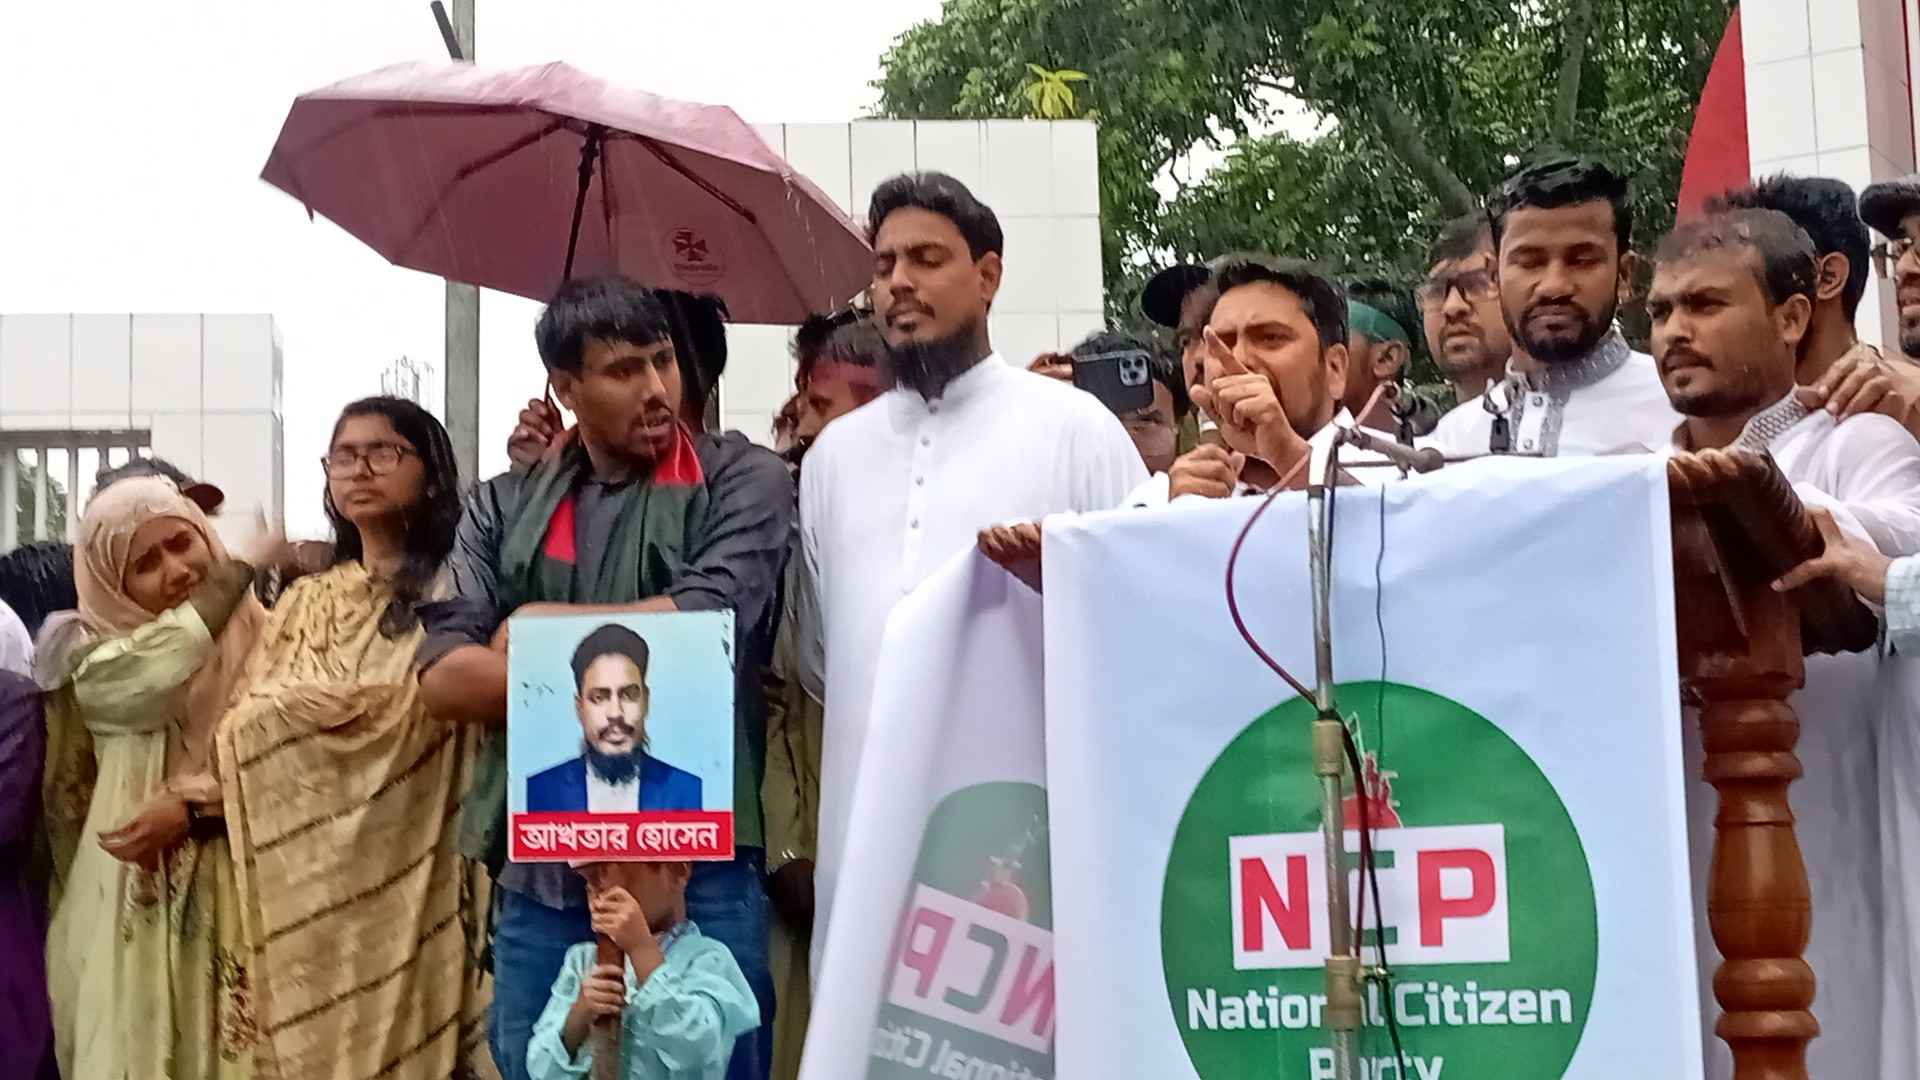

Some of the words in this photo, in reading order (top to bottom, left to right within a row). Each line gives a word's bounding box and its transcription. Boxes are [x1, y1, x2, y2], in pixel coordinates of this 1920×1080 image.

[519, 820, 629, 851] আখতার
[636, 820, 719, 851] হোসেন
[1186, 982, 1385, 1030] Nationl
[1394, 980, 1573, 1026] Citizen
